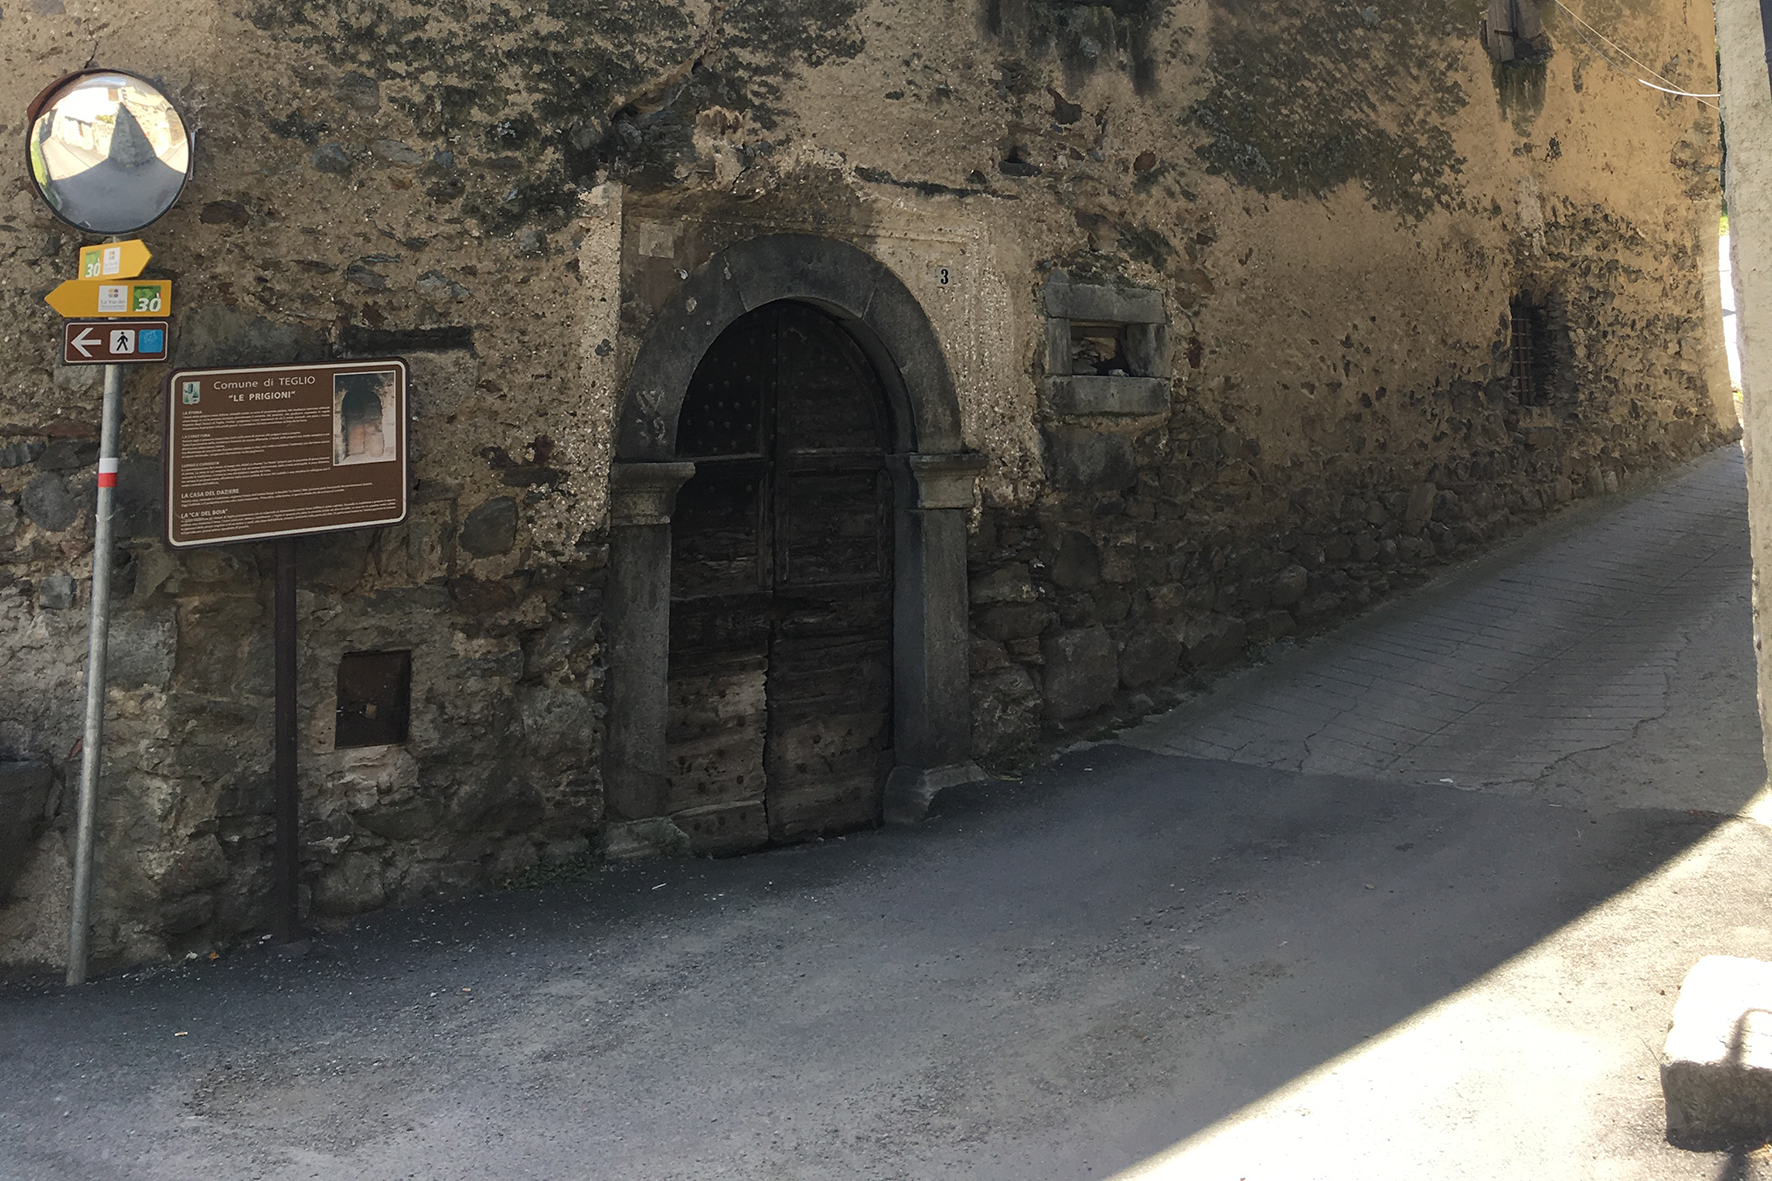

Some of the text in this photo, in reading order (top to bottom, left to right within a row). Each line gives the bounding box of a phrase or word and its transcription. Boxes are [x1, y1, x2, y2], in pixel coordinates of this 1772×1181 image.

[85, 263, 100, 277] 30
[940, 268, 949, 285] 3
[135, 298, 161, 312] 30
[213, 375, 316, 390] Comune di TEGLIO
